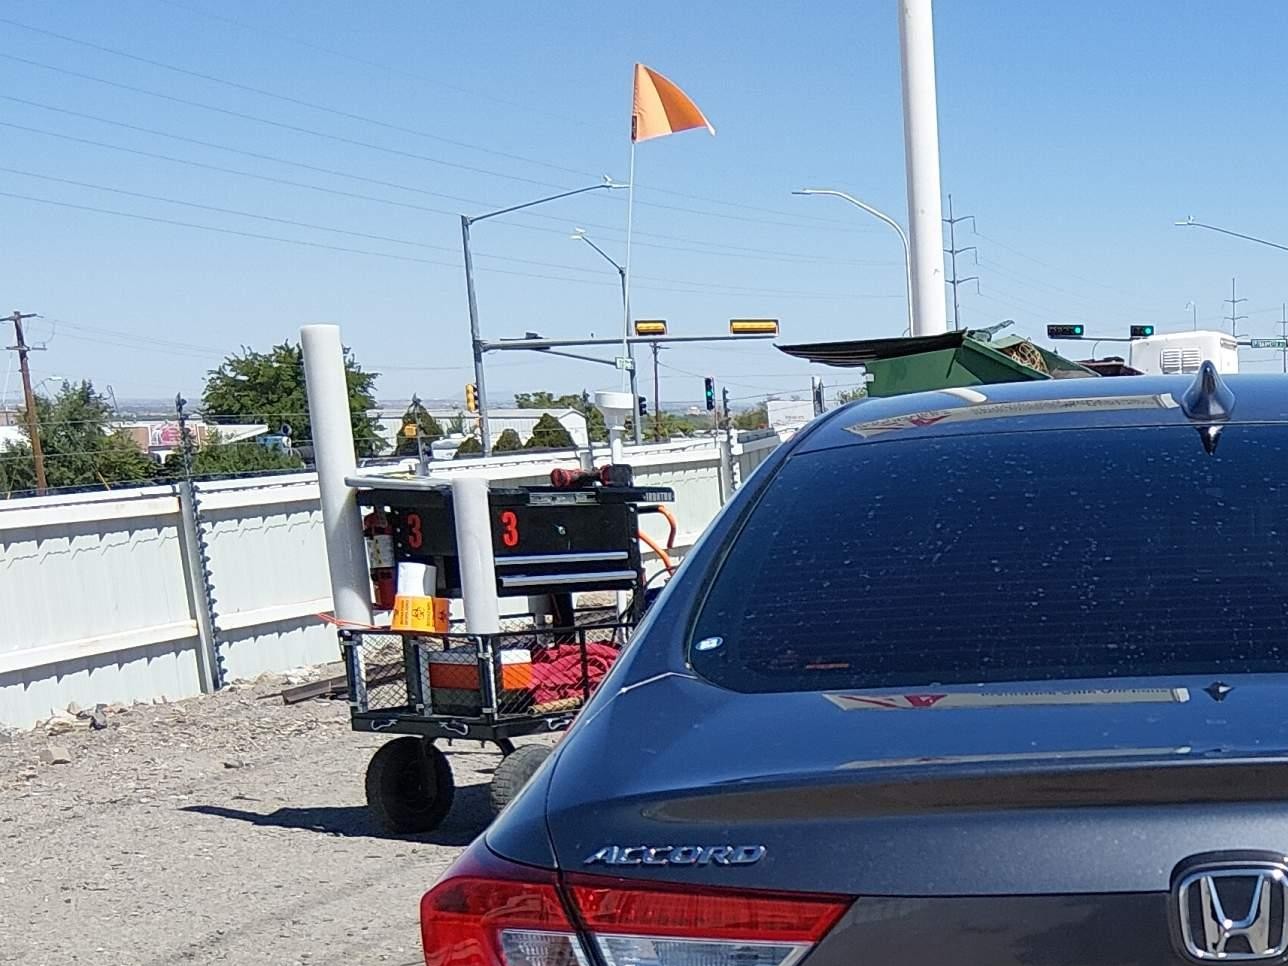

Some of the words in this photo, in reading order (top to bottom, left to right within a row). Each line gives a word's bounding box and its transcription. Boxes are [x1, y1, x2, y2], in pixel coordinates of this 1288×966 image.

[407, 514, 423, 549] 3
[501, 510, 519, 547] 3
[584, 845, 767, 865] ACCORD
